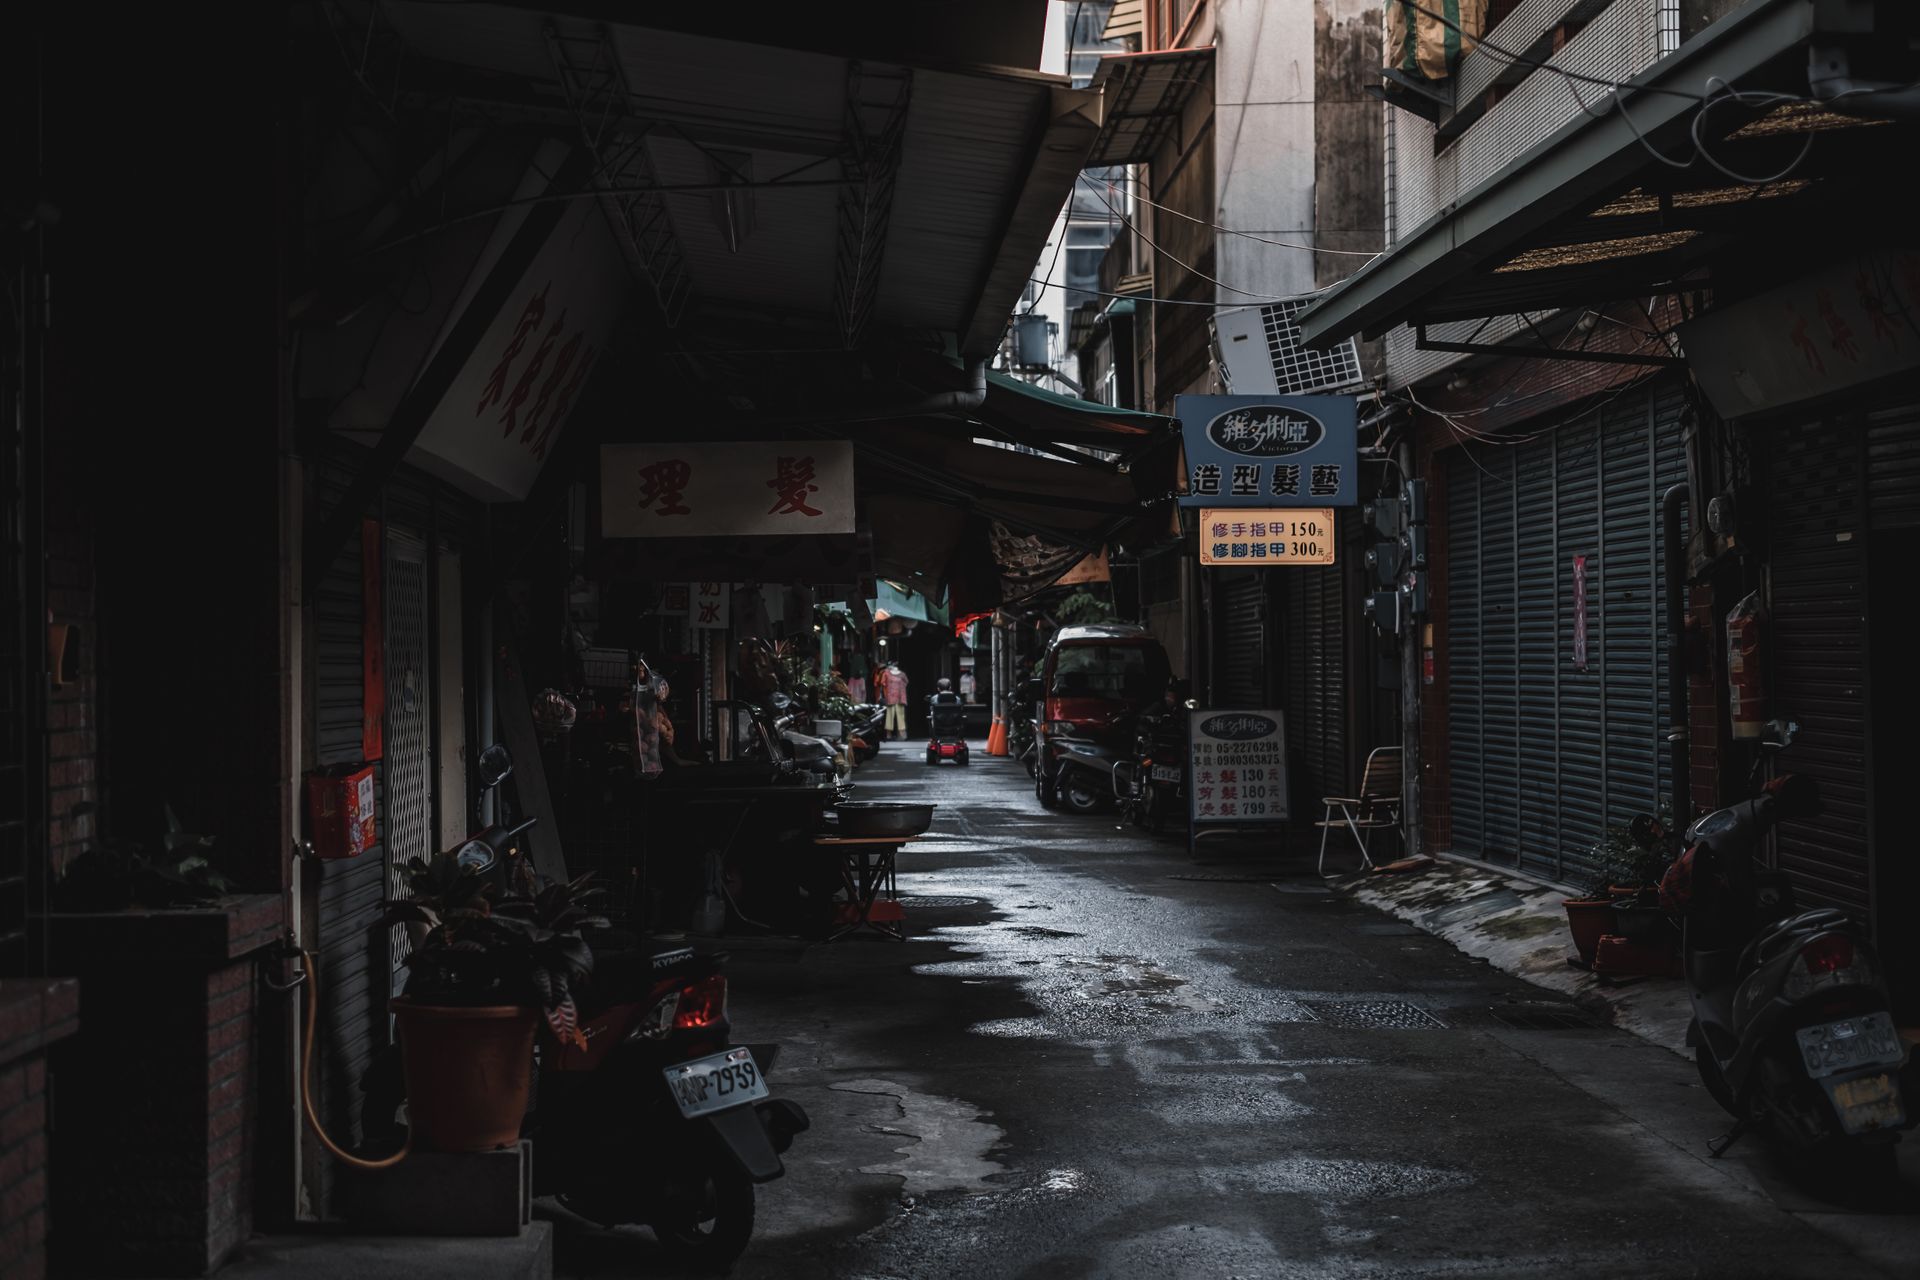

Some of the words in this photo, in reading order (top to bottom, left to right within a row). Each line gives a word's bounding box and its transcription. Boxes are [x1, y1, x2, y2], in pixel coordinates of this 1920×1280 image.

[638, 456, 824, 517] 理髮
[1191, 463, 1341, 498] 造型髮藝
[1211, 522, 1285, 538] 修手指甲
[1211, 542, 1286, 558] 修腳指甲
[1242, 769, 1264, 782] 130
[1242, 785, 1265, 798] 180
[1243, 802, 1265, 815] 799
